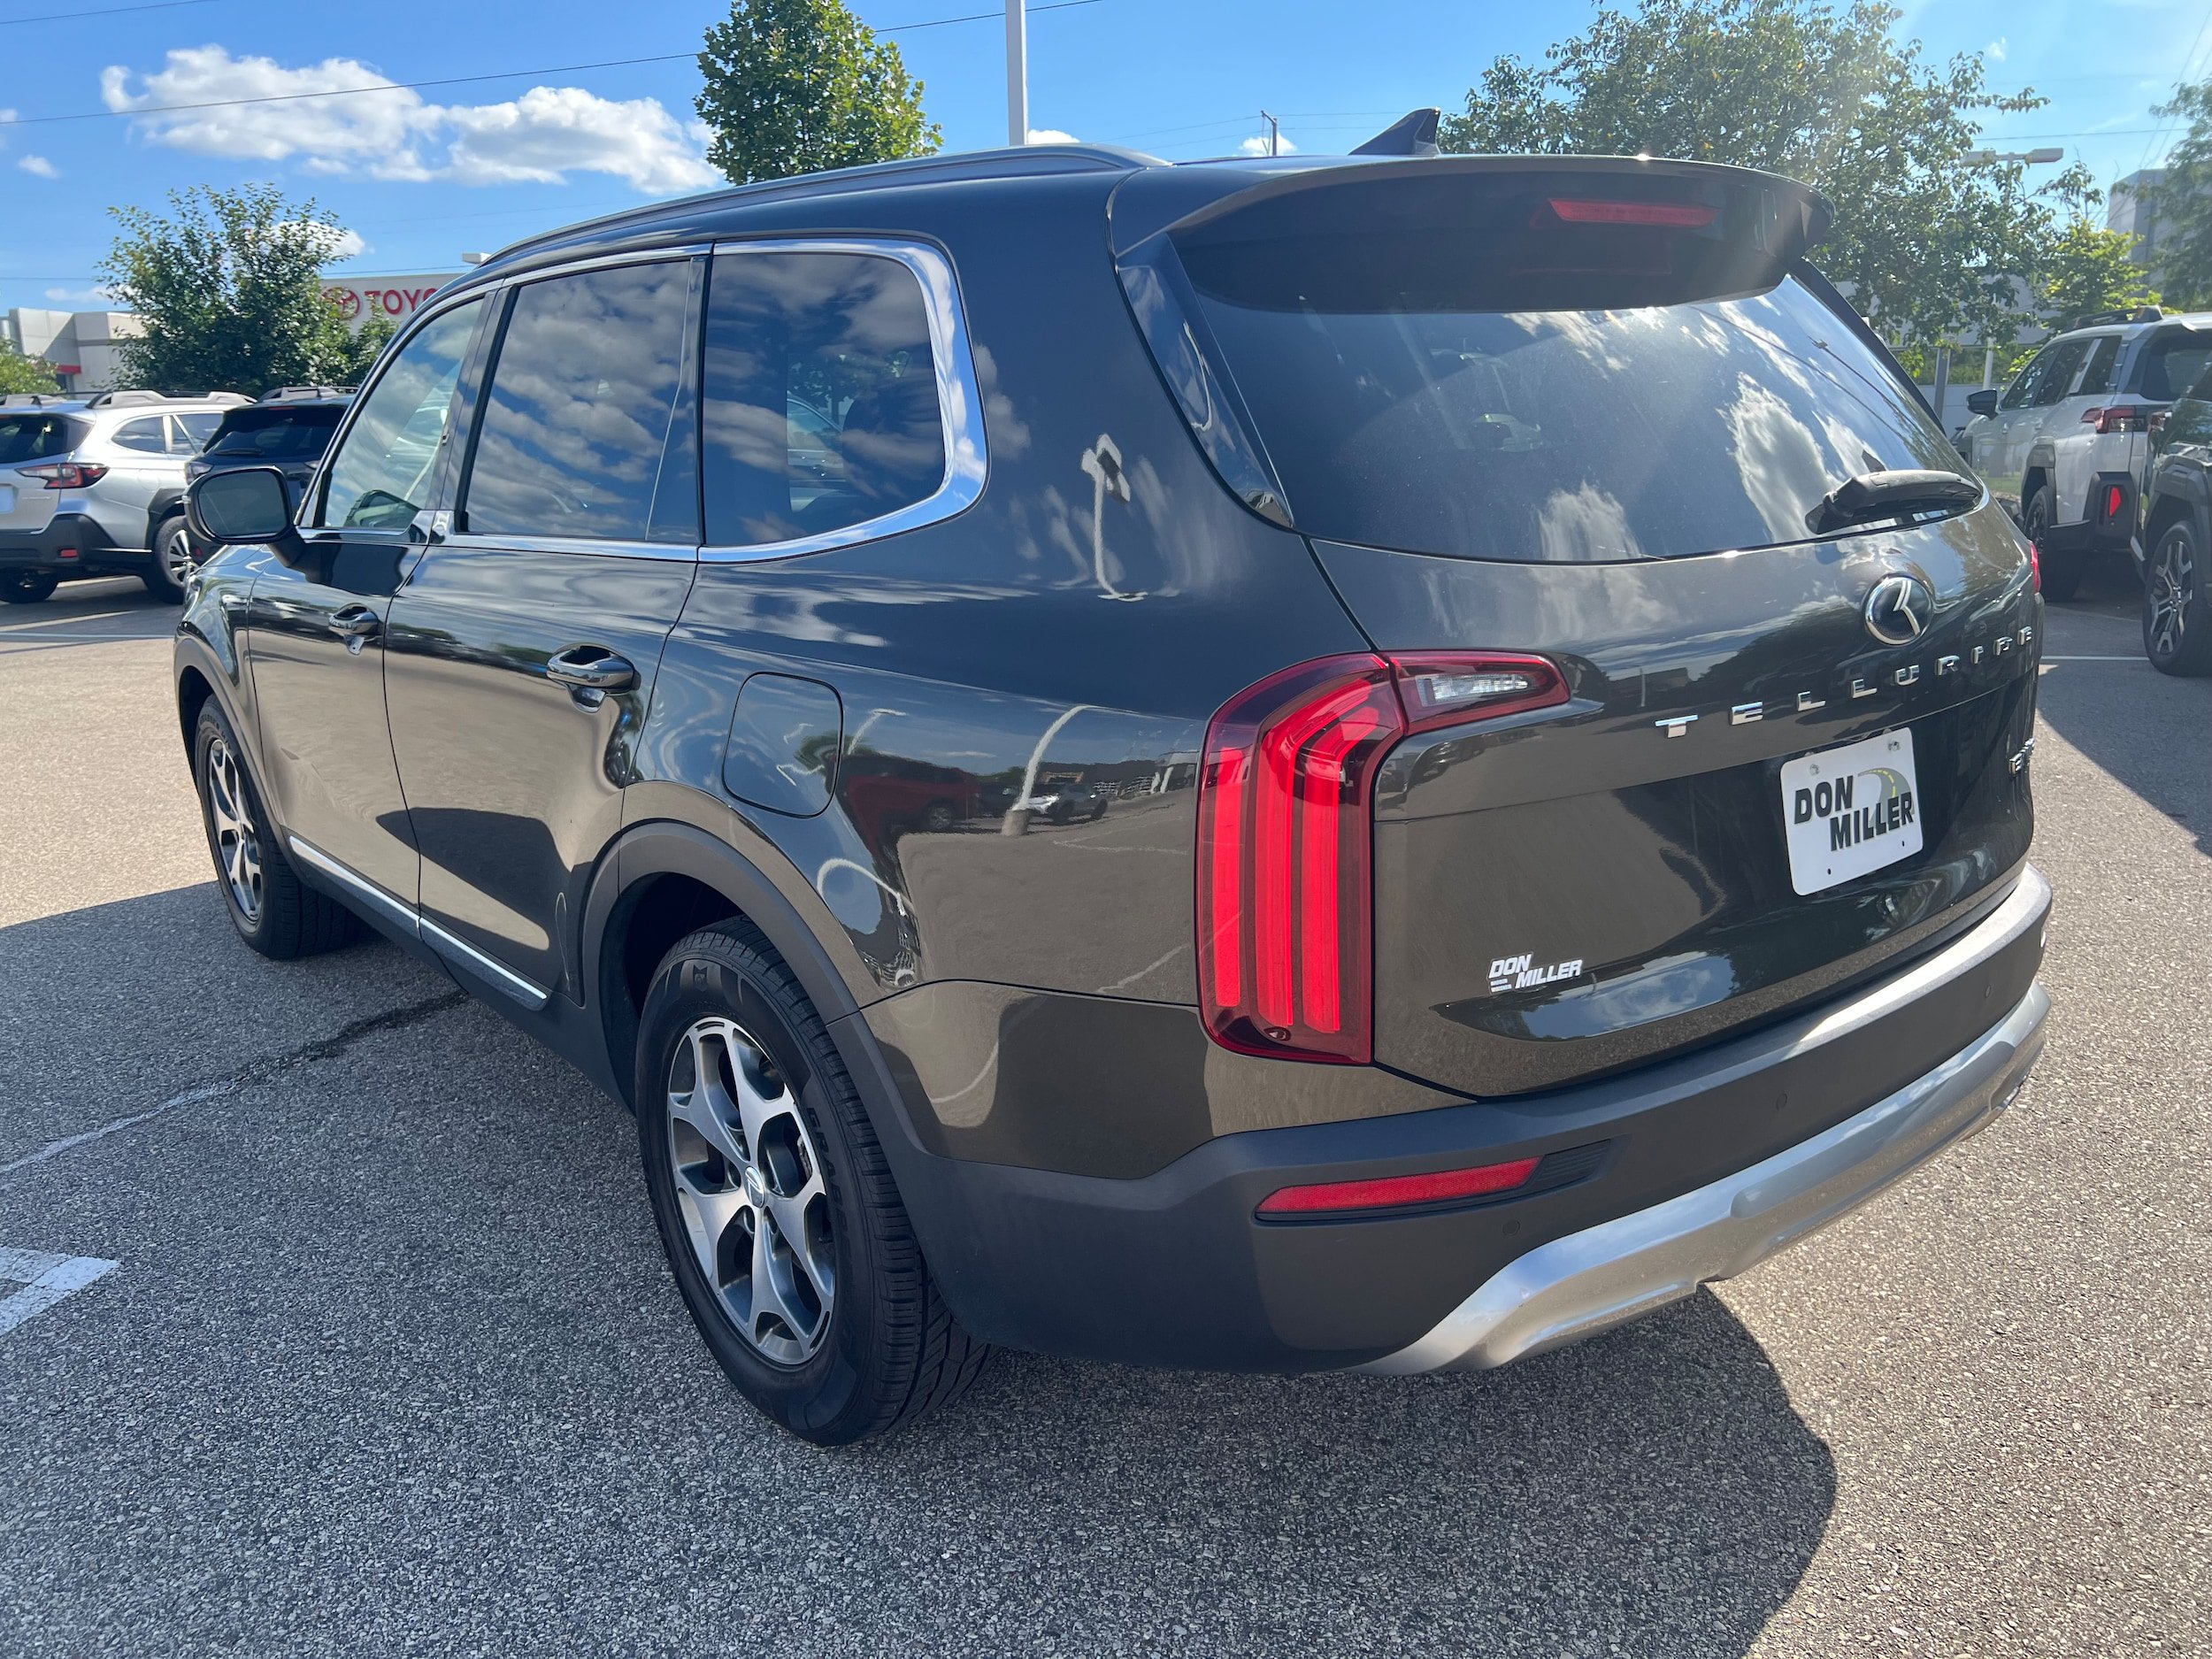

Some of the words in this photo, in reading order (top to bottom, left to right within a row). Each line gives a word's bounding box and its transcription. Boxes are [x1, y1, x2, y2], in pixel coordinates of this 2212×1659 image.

[1655, 625, 2033, 738] TELLURIDE
[1794, 775, 1854, 825] DON
[1830, 792, 1914, 852] MILLER
[1488, 954, 1532, 979] DON
[1515, 959, 1583, 989] MILLER
